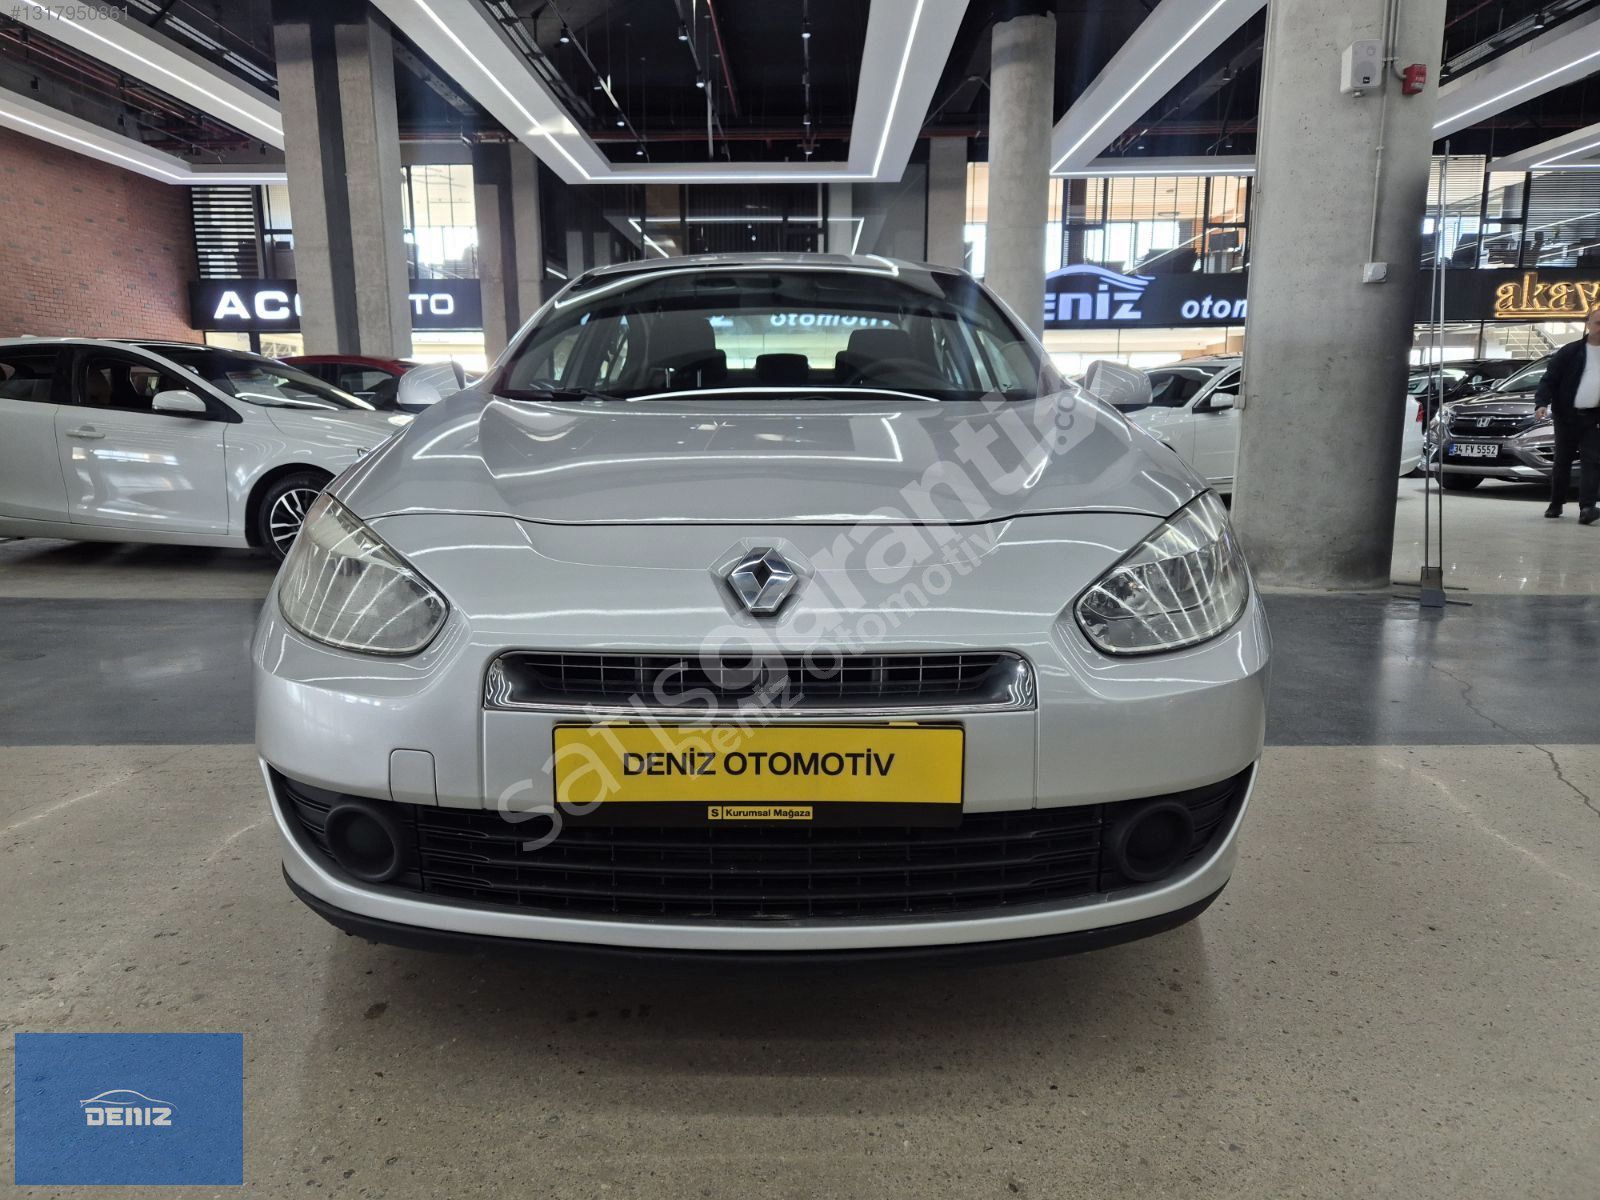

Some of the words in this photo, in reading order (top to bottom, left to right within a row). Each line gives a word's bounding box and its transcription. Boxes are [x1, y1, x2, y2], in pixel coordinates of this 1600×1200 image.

[213, 289, 303, 321] AC
[1476, 445, 1497, 455] 5552
[622, 746, 717, 778] DENİZ
[723, 748, 896, 778] OTOMOTİV
[710, 808, 721, 818] S
[725, 808, 771, 817] Kurumsal
[773, 808, 811, 819] Mağaza
